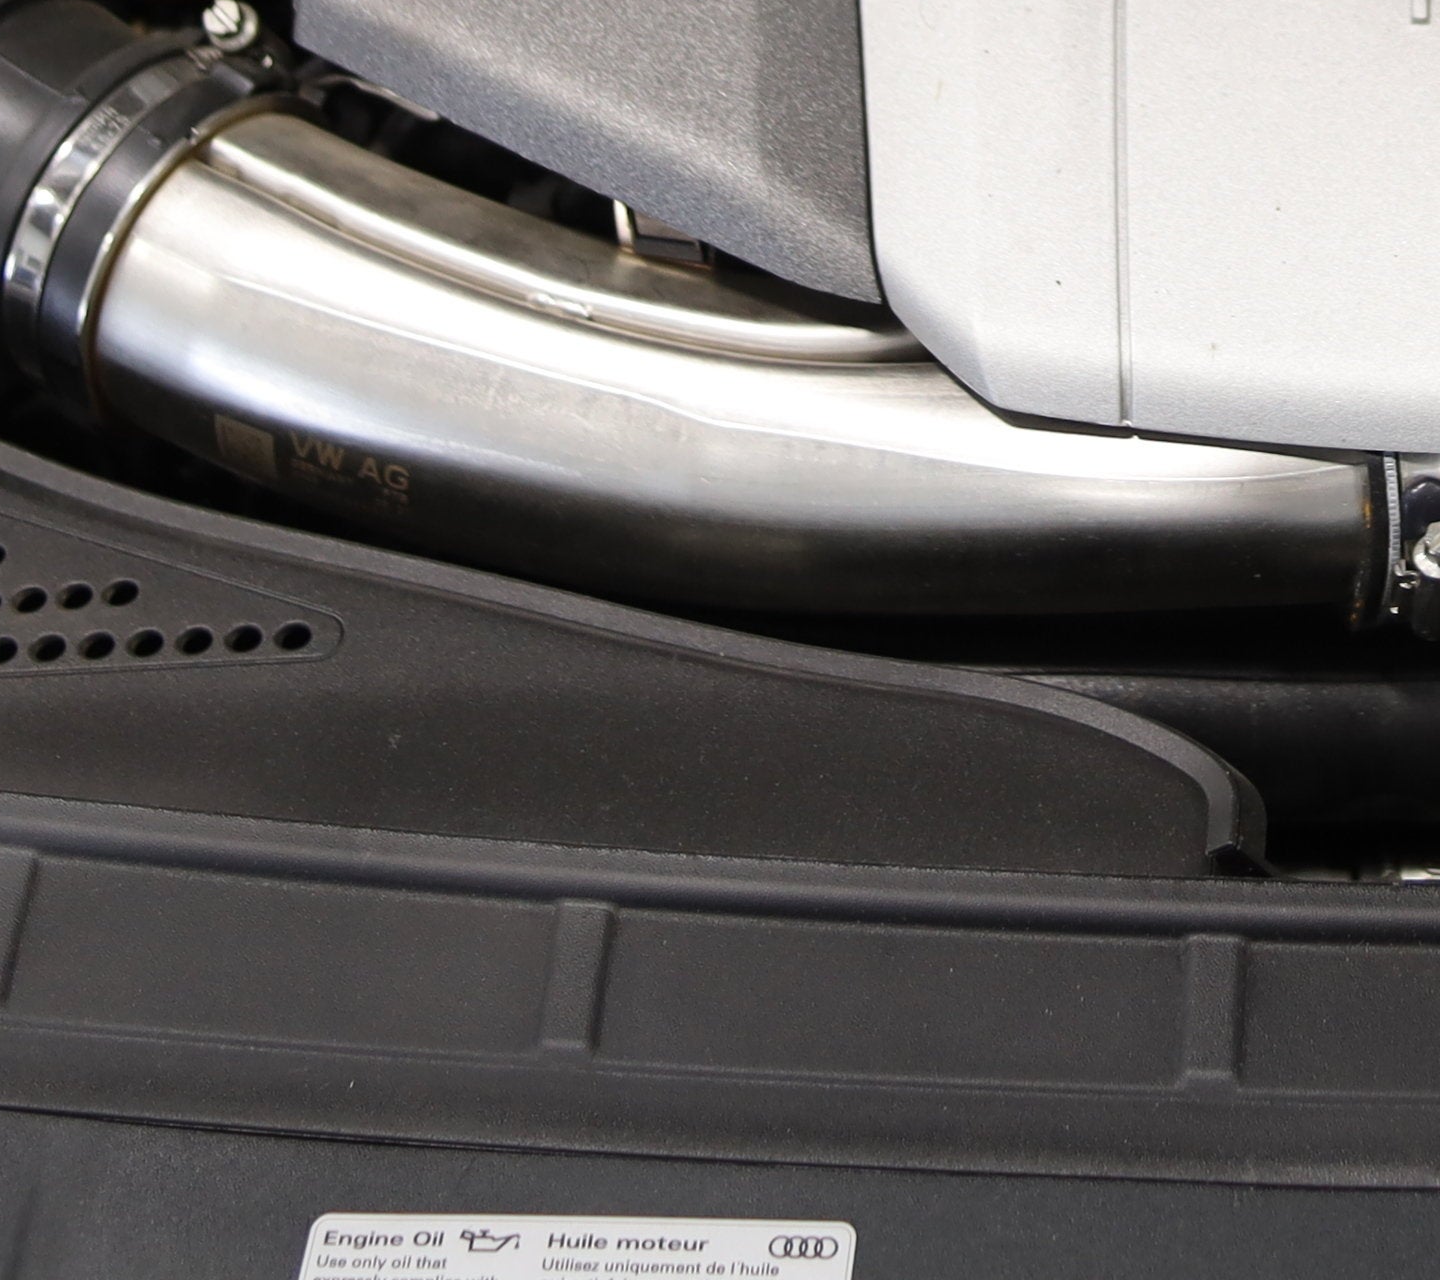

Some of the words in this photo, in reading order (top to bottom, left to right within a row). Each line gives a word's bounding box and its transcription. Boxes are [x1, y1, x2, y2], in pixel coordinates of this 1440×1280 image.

[289, 430, 346, 471] VW
[358, 456, 410, 490] AG
[323, 1231, 404, 1249] Engine
[413, 1231, 445, 1247] Oil
[547, 1233, 608, 1250] Huile
[616, 1235, 709, 1252] moteur
[316, 1255, 348, 1269] Use
[352, 1256, 387, 1271] only
[391, 1256, 411, 1269] oil
[416, 1256, 447, 1270] that
[541, 1257, 600, 1273] Utilisez
[604, 1260, 701, 1276] uniquement
[706, 1261, 726, 1276] de
[730, 1261, 780, 1277] l'huile
